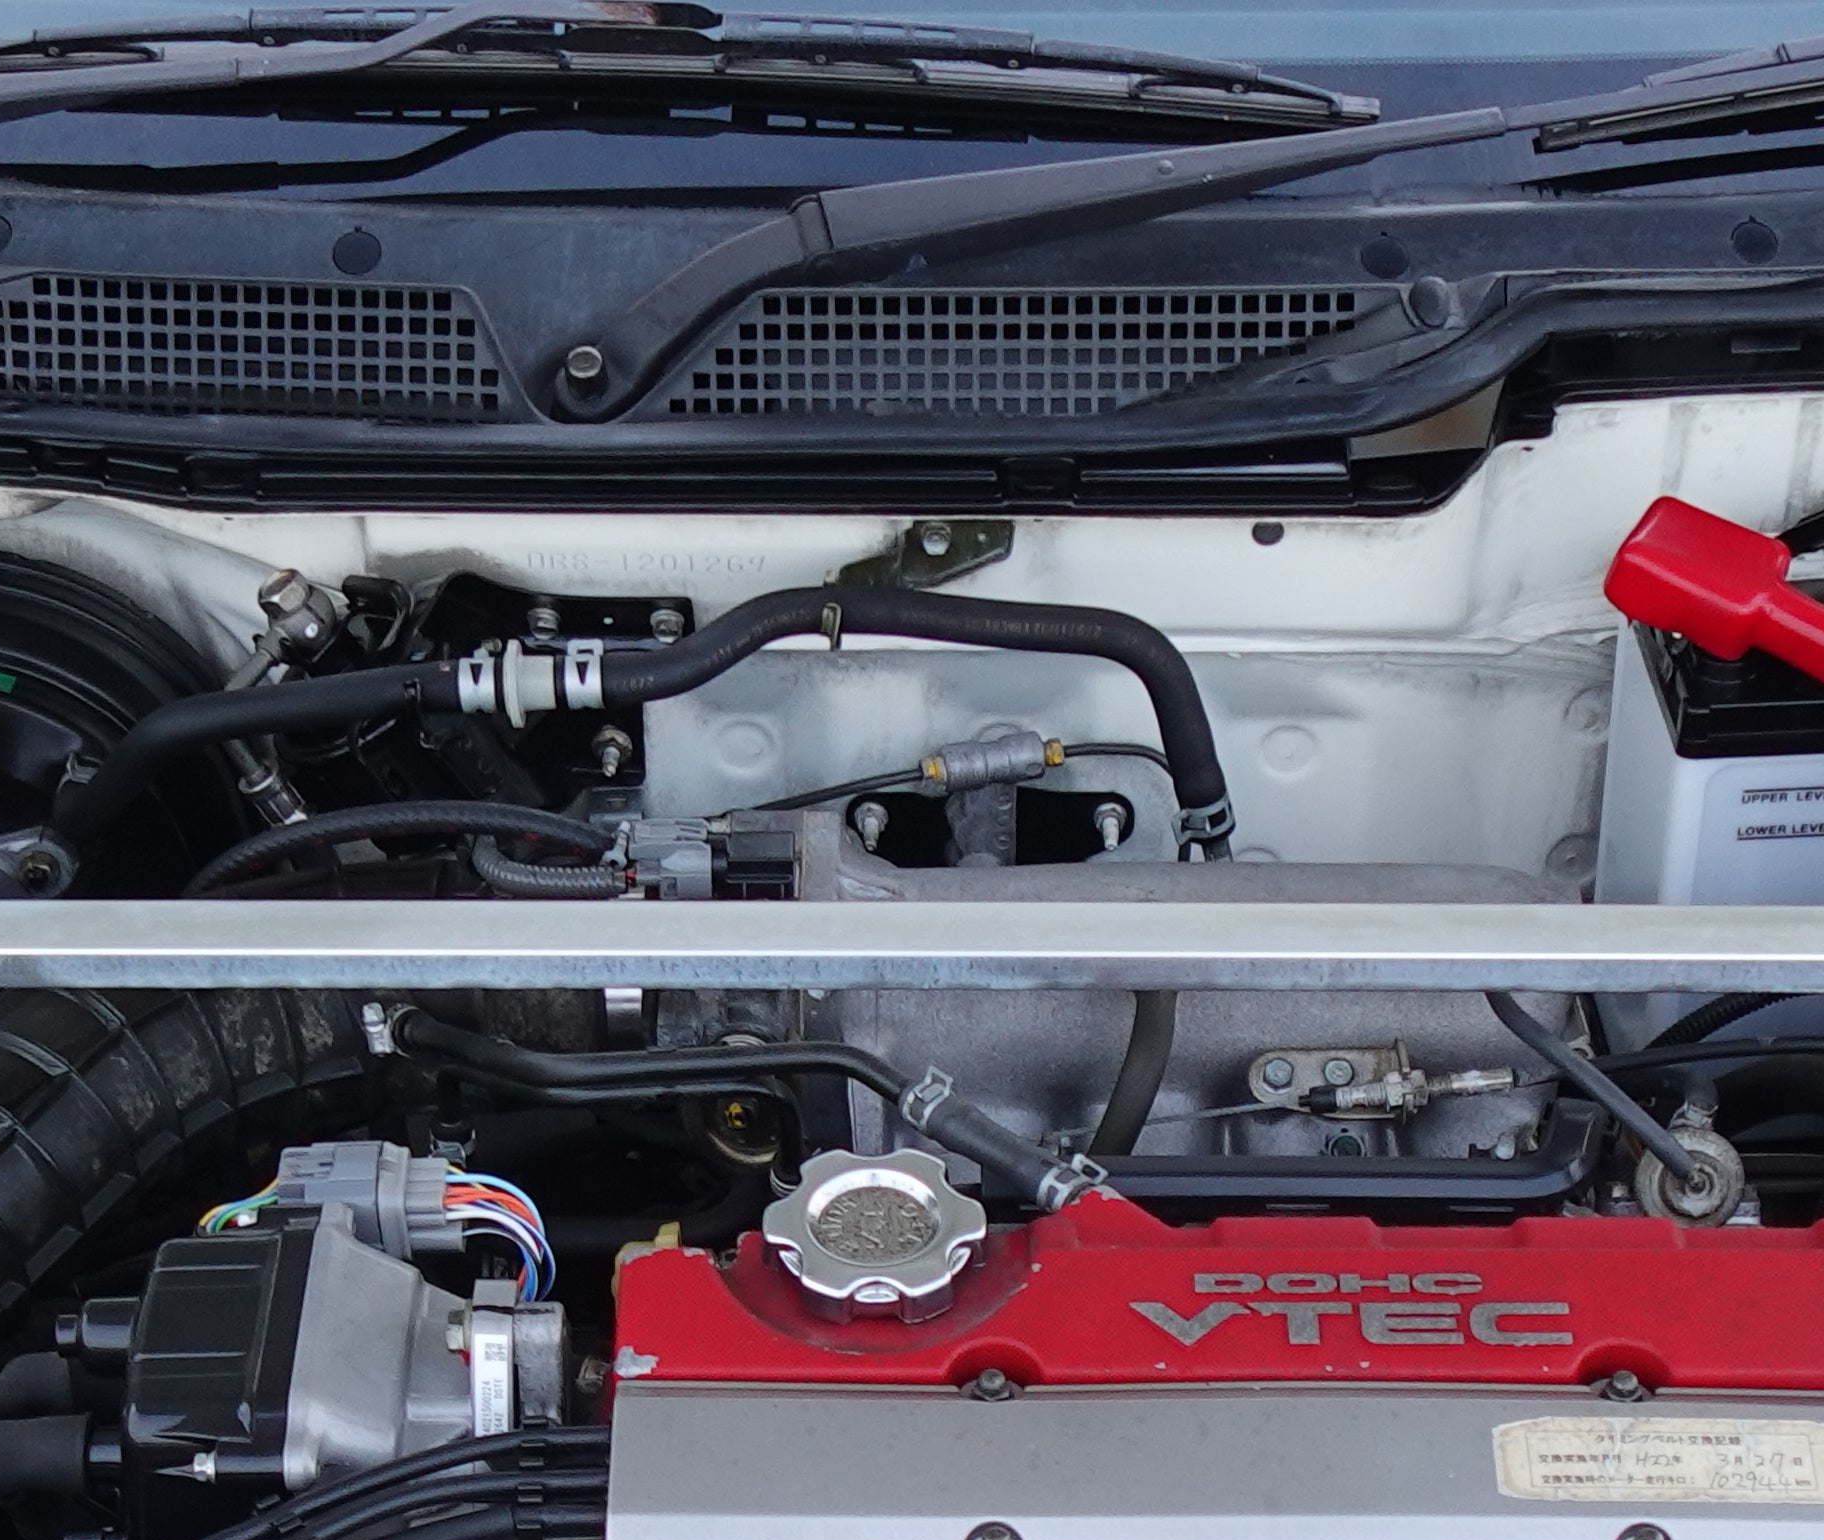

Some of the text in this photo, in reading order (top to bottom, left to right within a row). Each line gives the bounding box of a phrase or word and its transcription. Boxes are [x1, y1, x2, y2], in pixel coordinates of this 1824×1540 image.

[1742, 792, 1788, 804] UPPER
[1737, 824, 1787, 837] LOWER
[1194, 1273, 1483, 1295] DOHC
[1129, 1301, 1574, 1347] VTEC
